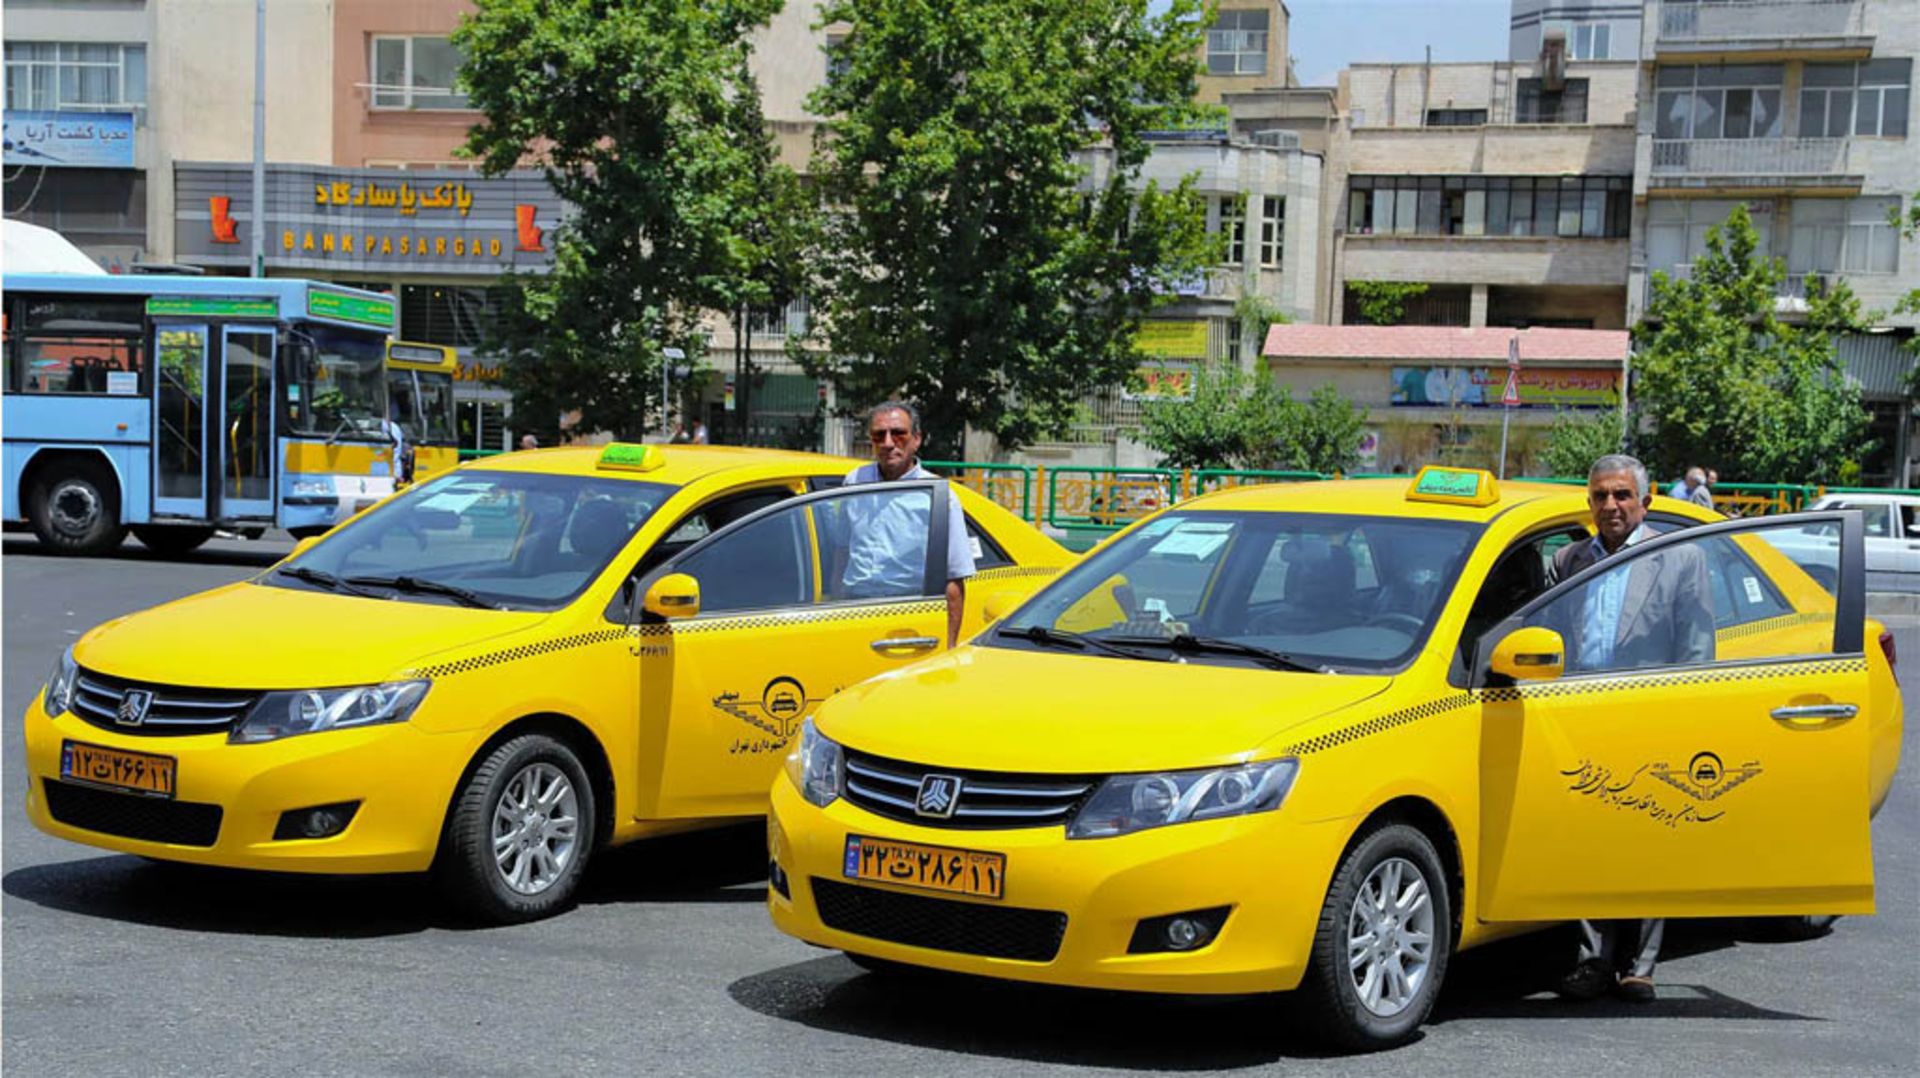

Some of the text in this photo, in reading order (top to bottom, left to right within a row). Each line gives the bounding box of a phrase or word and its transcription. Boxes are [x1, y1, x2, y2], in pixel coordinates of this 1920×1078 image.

[57, 125, 95, 140] گشت
[421, 181, 473, 216] بانک
[282, 230, 503, 257] BANK PASARGAD
